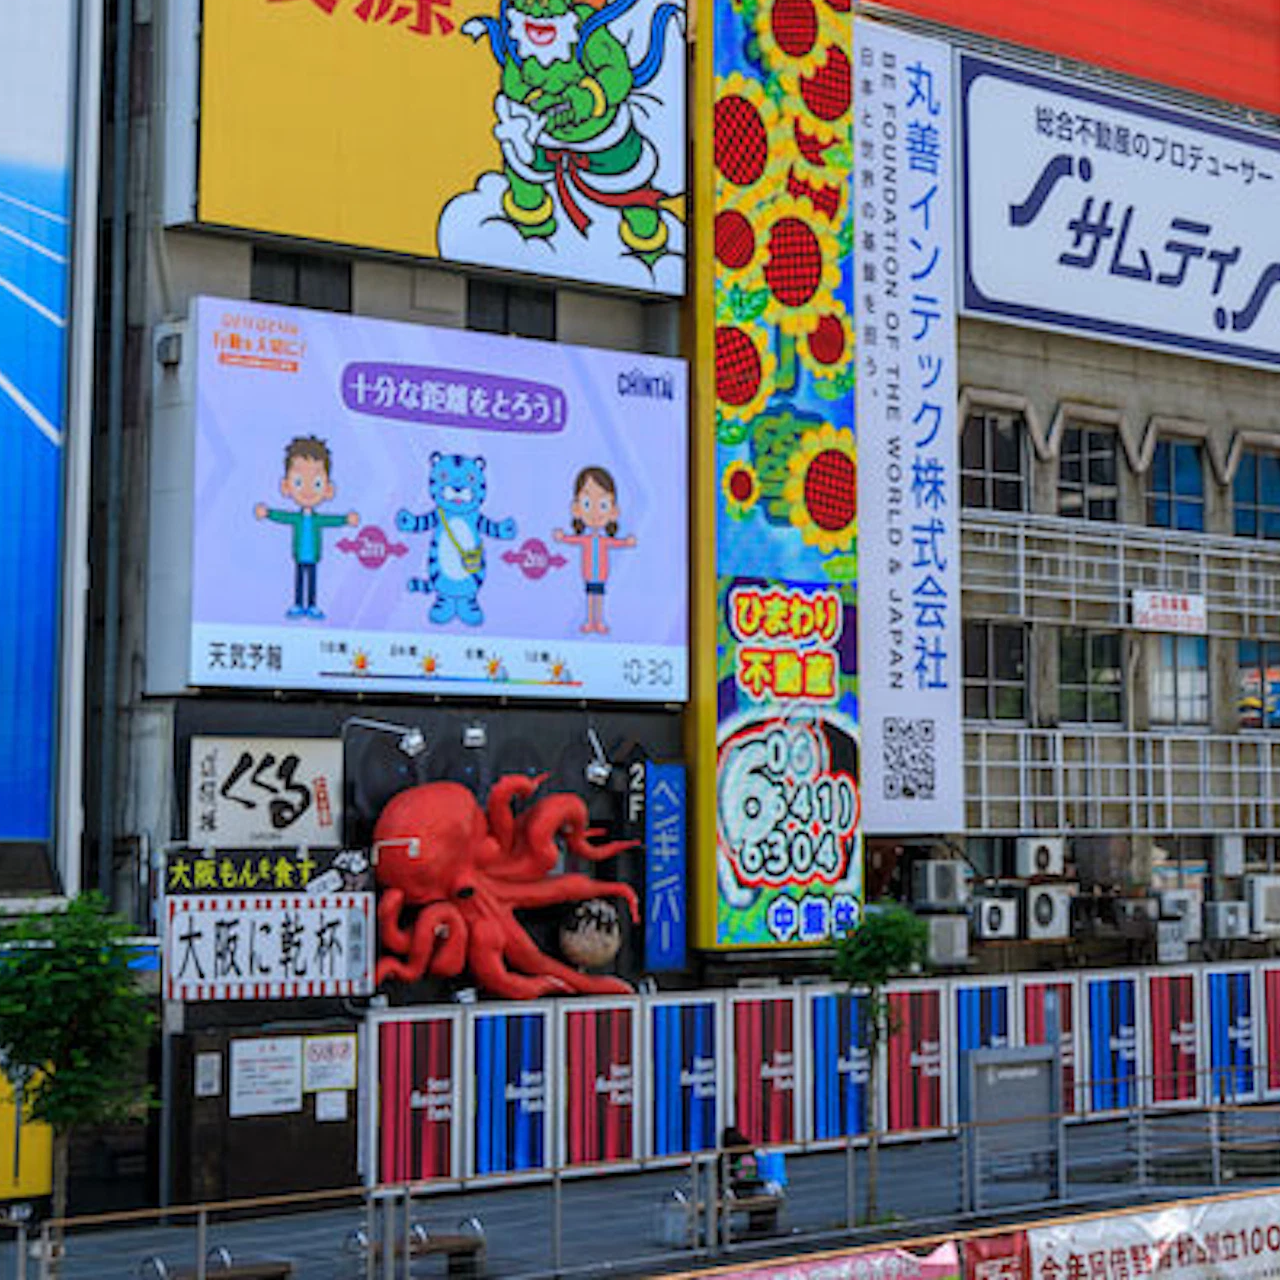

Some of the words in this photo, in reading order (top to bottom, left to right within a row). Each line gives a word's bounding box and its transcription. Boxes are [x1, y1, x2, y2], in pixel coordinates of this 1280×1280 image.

[881, 51, 897, 89] BE
[1035, 104, 1275, 186] 総合不動産のプロデューサー
[882, 103, 900, 298] FOUNDATION
[885, 312, 900, 350] OF
[885, 365, 901, 421] THE
[904, 60, 950, 692] 丸善インテック株式会社
[886, 436, 903, 545] WORLD
[734, 591, 841, 641] ひまわり
[888, 588, 904, 691] JAPAN
[739, 646, 838, 701] 不動産
[220, 751, 312, 830] くくる
[628, 762, 645, 821] 2F
[178, 910, 344, 981] 大阪に乾杯
